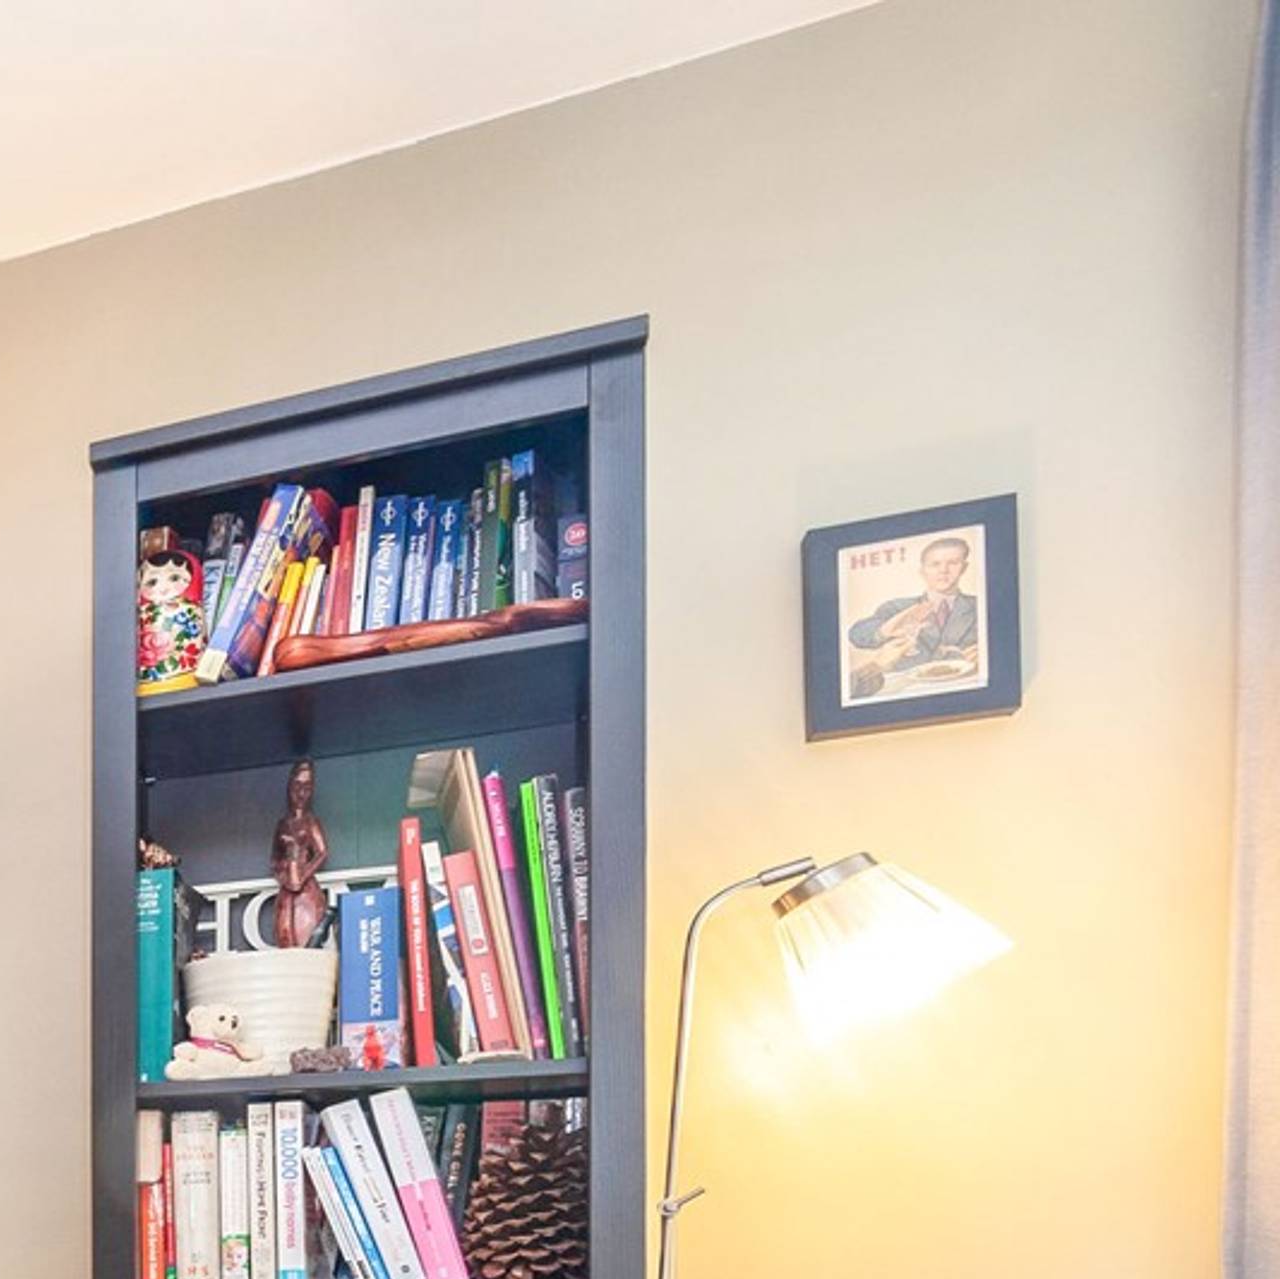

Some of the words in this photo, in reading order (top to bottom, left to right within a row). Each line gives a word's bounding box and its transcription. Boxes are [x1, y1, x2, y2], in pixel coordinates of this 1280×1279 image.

[376, 532, 395, 570] New
[373, 575, 393, 629] Zealan
[370, 916, 382, 945] WAR
[370, 947, 382, 977] AND
[370, 979, 383, 1018] PEACE
[452, 1122, 467, 1156] GONE
[447, 1160, 462, 1188] GIRL
[283, 1182, 296, 1208] baby
[286, 1209, 296, 1248] names
